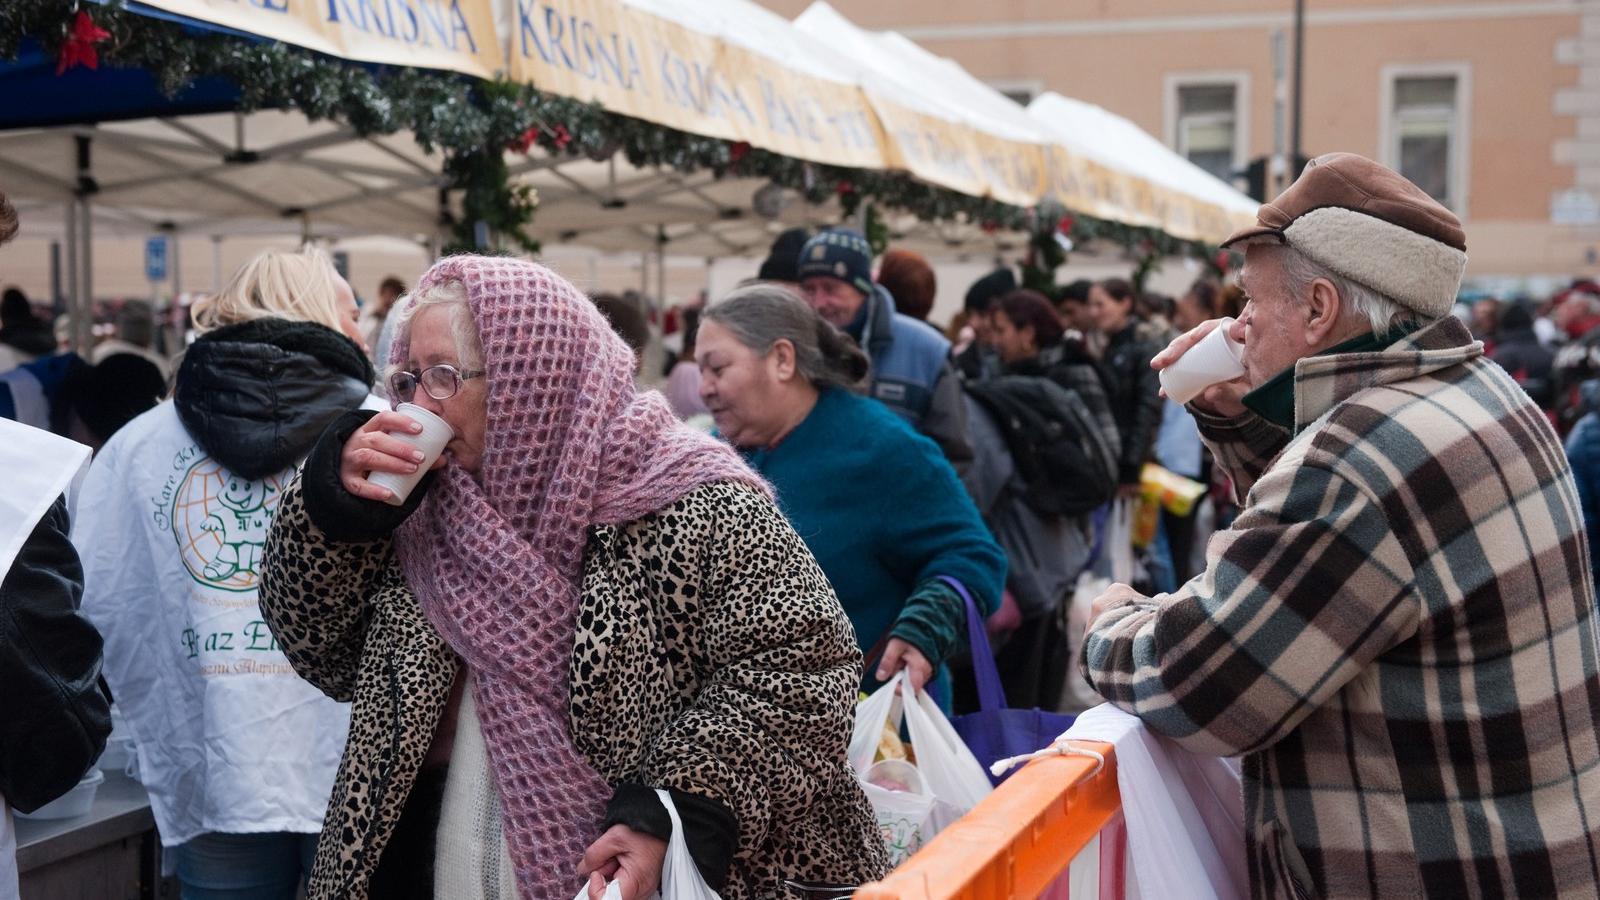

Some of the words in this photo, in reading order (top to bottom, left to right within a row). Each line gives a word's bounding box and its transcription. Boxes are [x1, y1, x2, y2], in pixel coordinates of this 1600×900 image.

[517, 0, 651, 98] KRISNA
[151, 475, 177, 531] Hare
[204, 632, 234, 652] az
